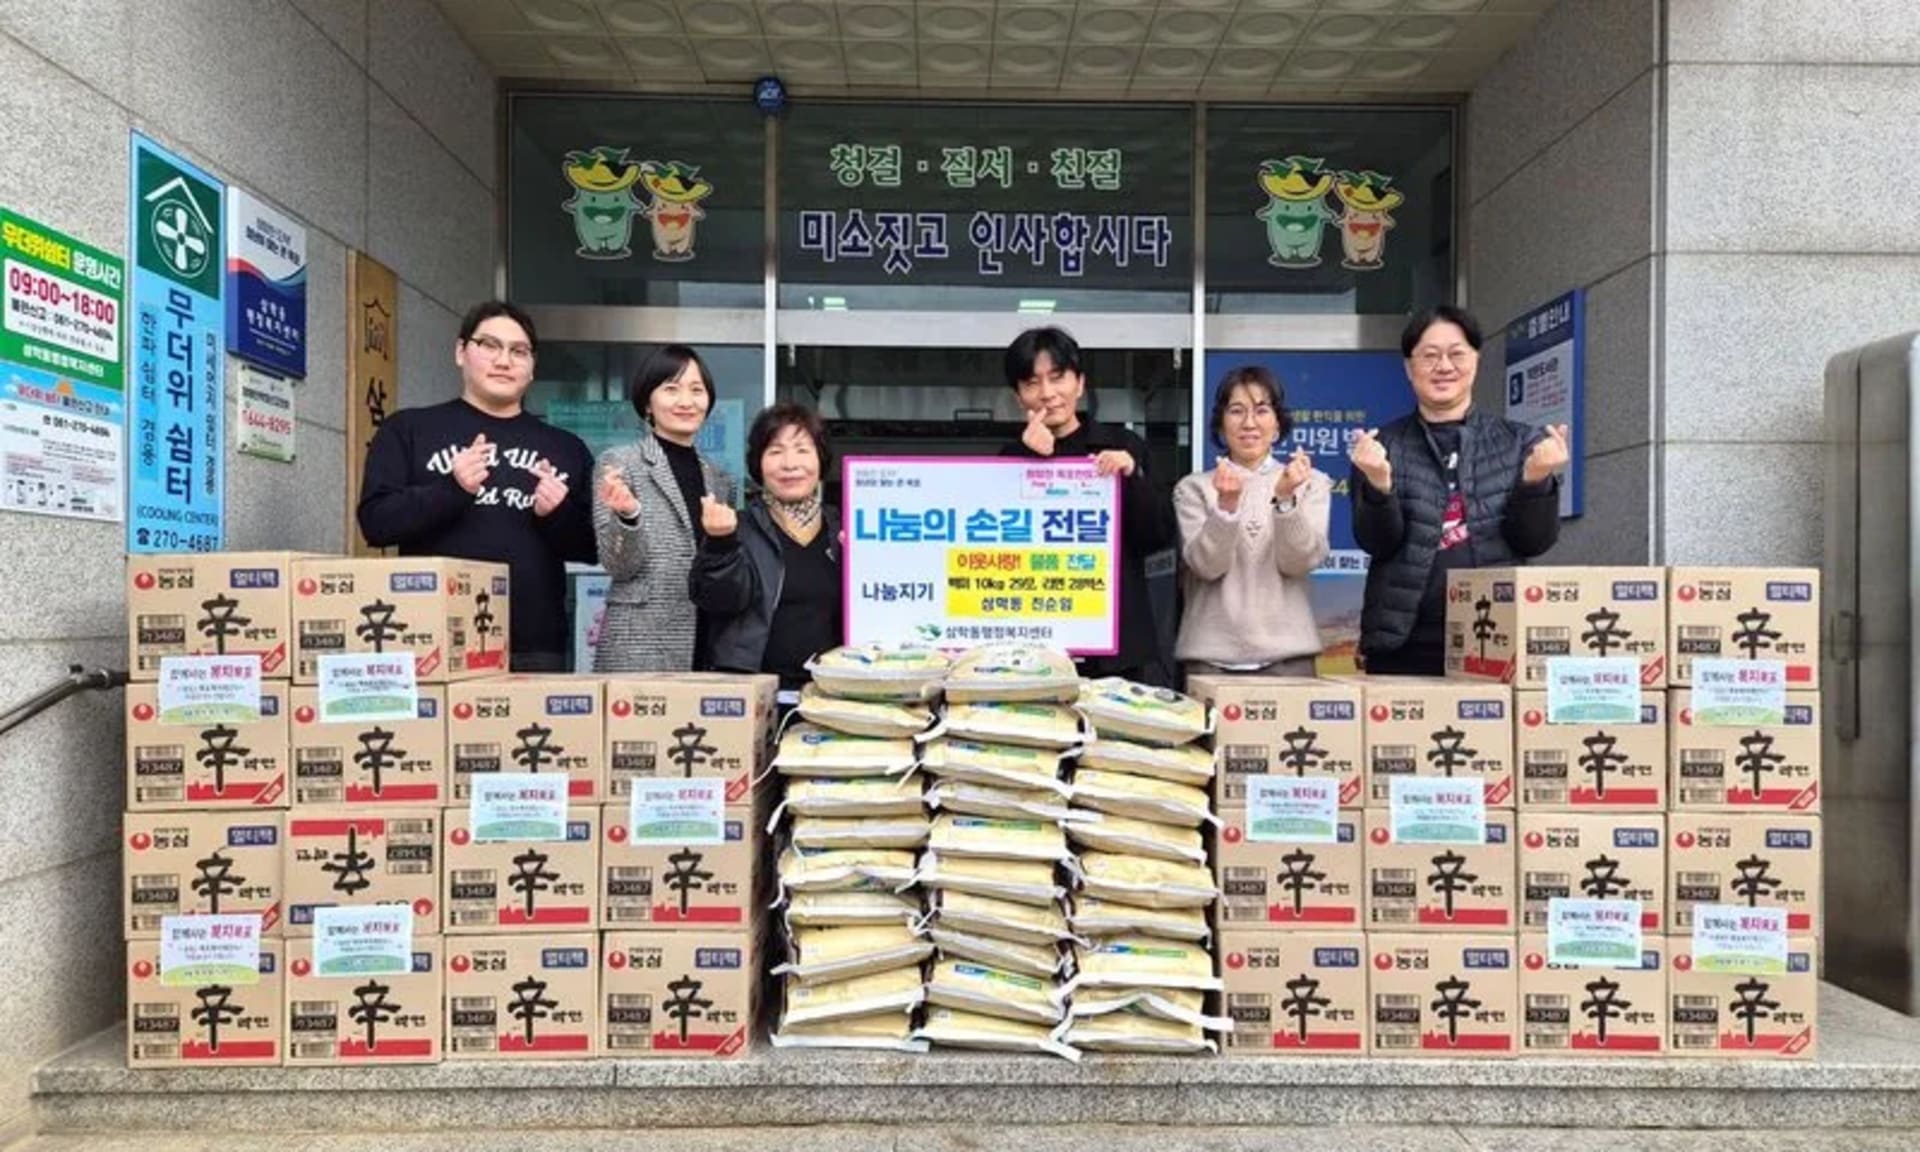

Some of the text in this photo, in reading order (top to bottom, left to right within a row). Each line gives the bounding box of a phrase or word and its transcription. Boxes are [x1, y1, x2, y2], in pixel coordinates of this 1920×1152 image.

[830, 143, 901, 186] 청결
[940, 146, 1011, 187] 질서
[1051, 148, 1121, 189] 친절
[800, 210, 1170, 276] 미소짓고 인사합시다
[10, 268, 114, 325] 09:00~18:00
[165, 423, 192, 505] 쉼터
[855, 508, 1109, 543] 나눔의 손길 전달
[957, 554, 1021, 571] 이웃사랑!
[159, 576, 193, 588] 농심
[320, 581, 354, 594] 농심
[862, 582, 934, 601] 나눔지기
[1547, 589, 1579, 601] 농심
[1699, 588, 1731, 600] 농심
[946, 625, 1052, 639] 삼학동행정복지센터
[476, 705, 510, 717] 농심
[634, 703, 666, 716] 농심
[1245, 707, 1276, 720] 농심
[1392, 708, 1423, 720] 농심
[154, 835, 189, 847] 농심
[1546, 835, 1579, 847] 농심
[1698, 835, 1730, 847] 농심
[473, 958, 506, 971] 농심
[629, 955, 661, 968] 농심
[1248, 955, 1279, 967] 농심
[1397, 956, 1428, 969] 농심
